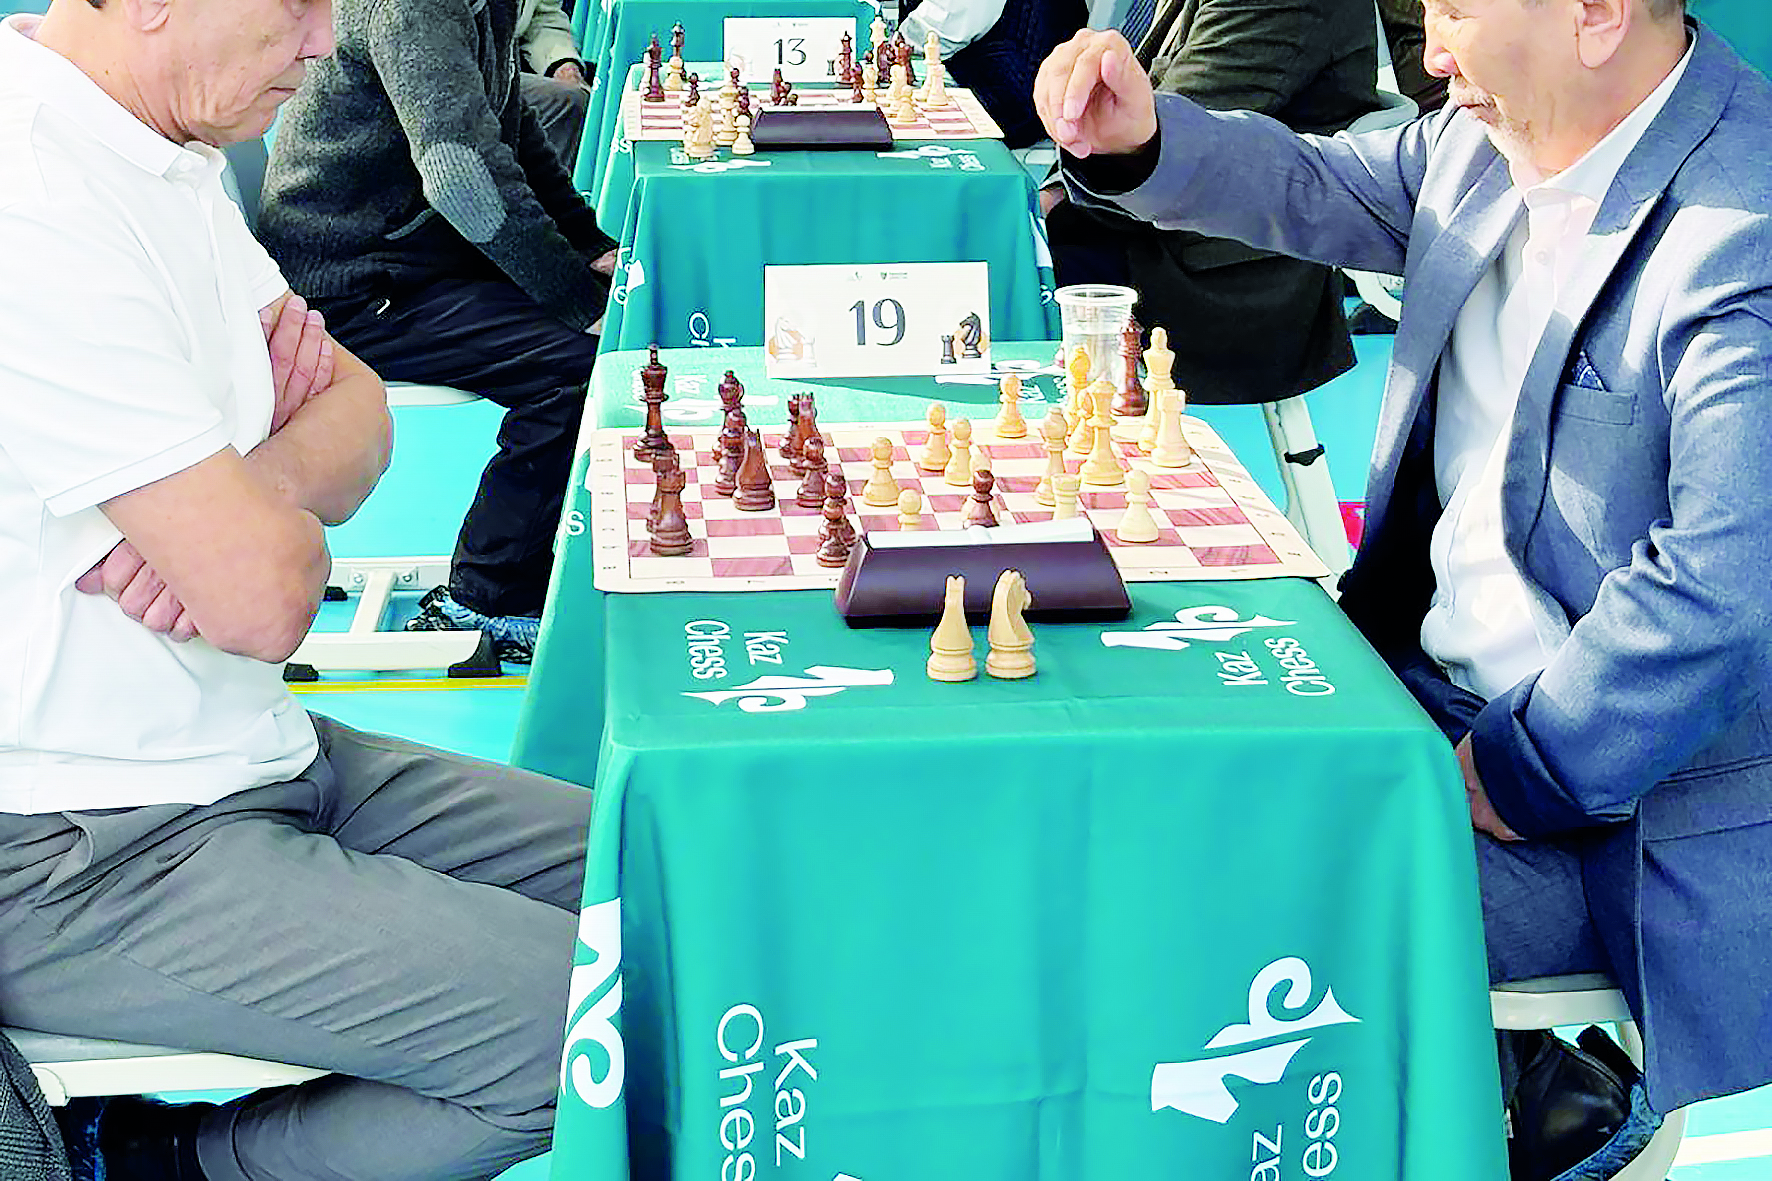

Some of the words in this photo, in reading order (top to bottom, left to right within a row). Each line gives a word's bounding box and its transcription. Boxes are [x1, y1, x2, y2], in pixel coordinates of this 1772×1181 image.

[773, 38, 807, 66] 13
[848, 298, 906, 347] 19
[684, 619, 732, 680] Chess
[743, 630, 790, 666] Kaz
[1215, 650, 1269, 686] Kaz
[1263, 637, 1336, 697] Chess
[775, 1038, 818, 1167] Kaz
